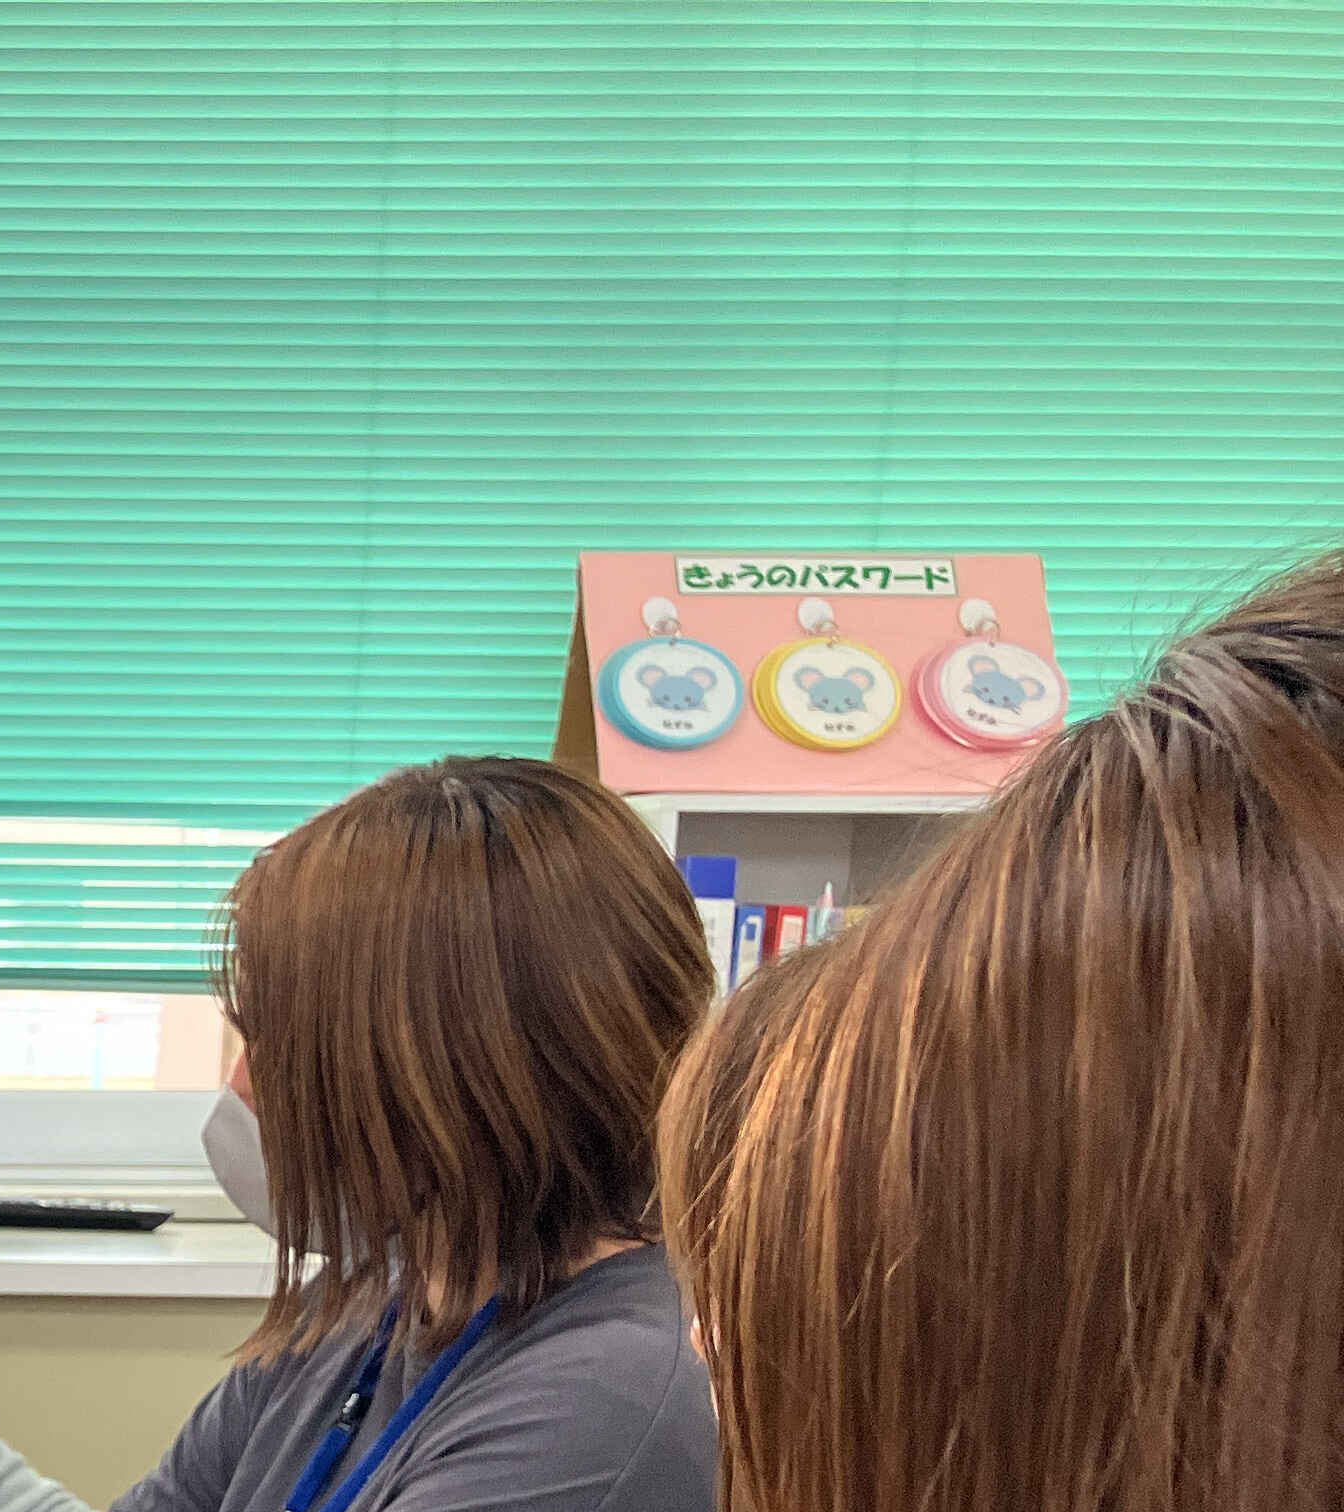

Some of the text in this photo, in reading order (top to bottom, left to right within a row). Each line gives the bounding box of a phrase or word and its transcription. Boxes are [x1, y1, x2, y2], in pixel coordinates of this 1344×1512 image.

[682, 563, 951, 590] きょうのパスワード
